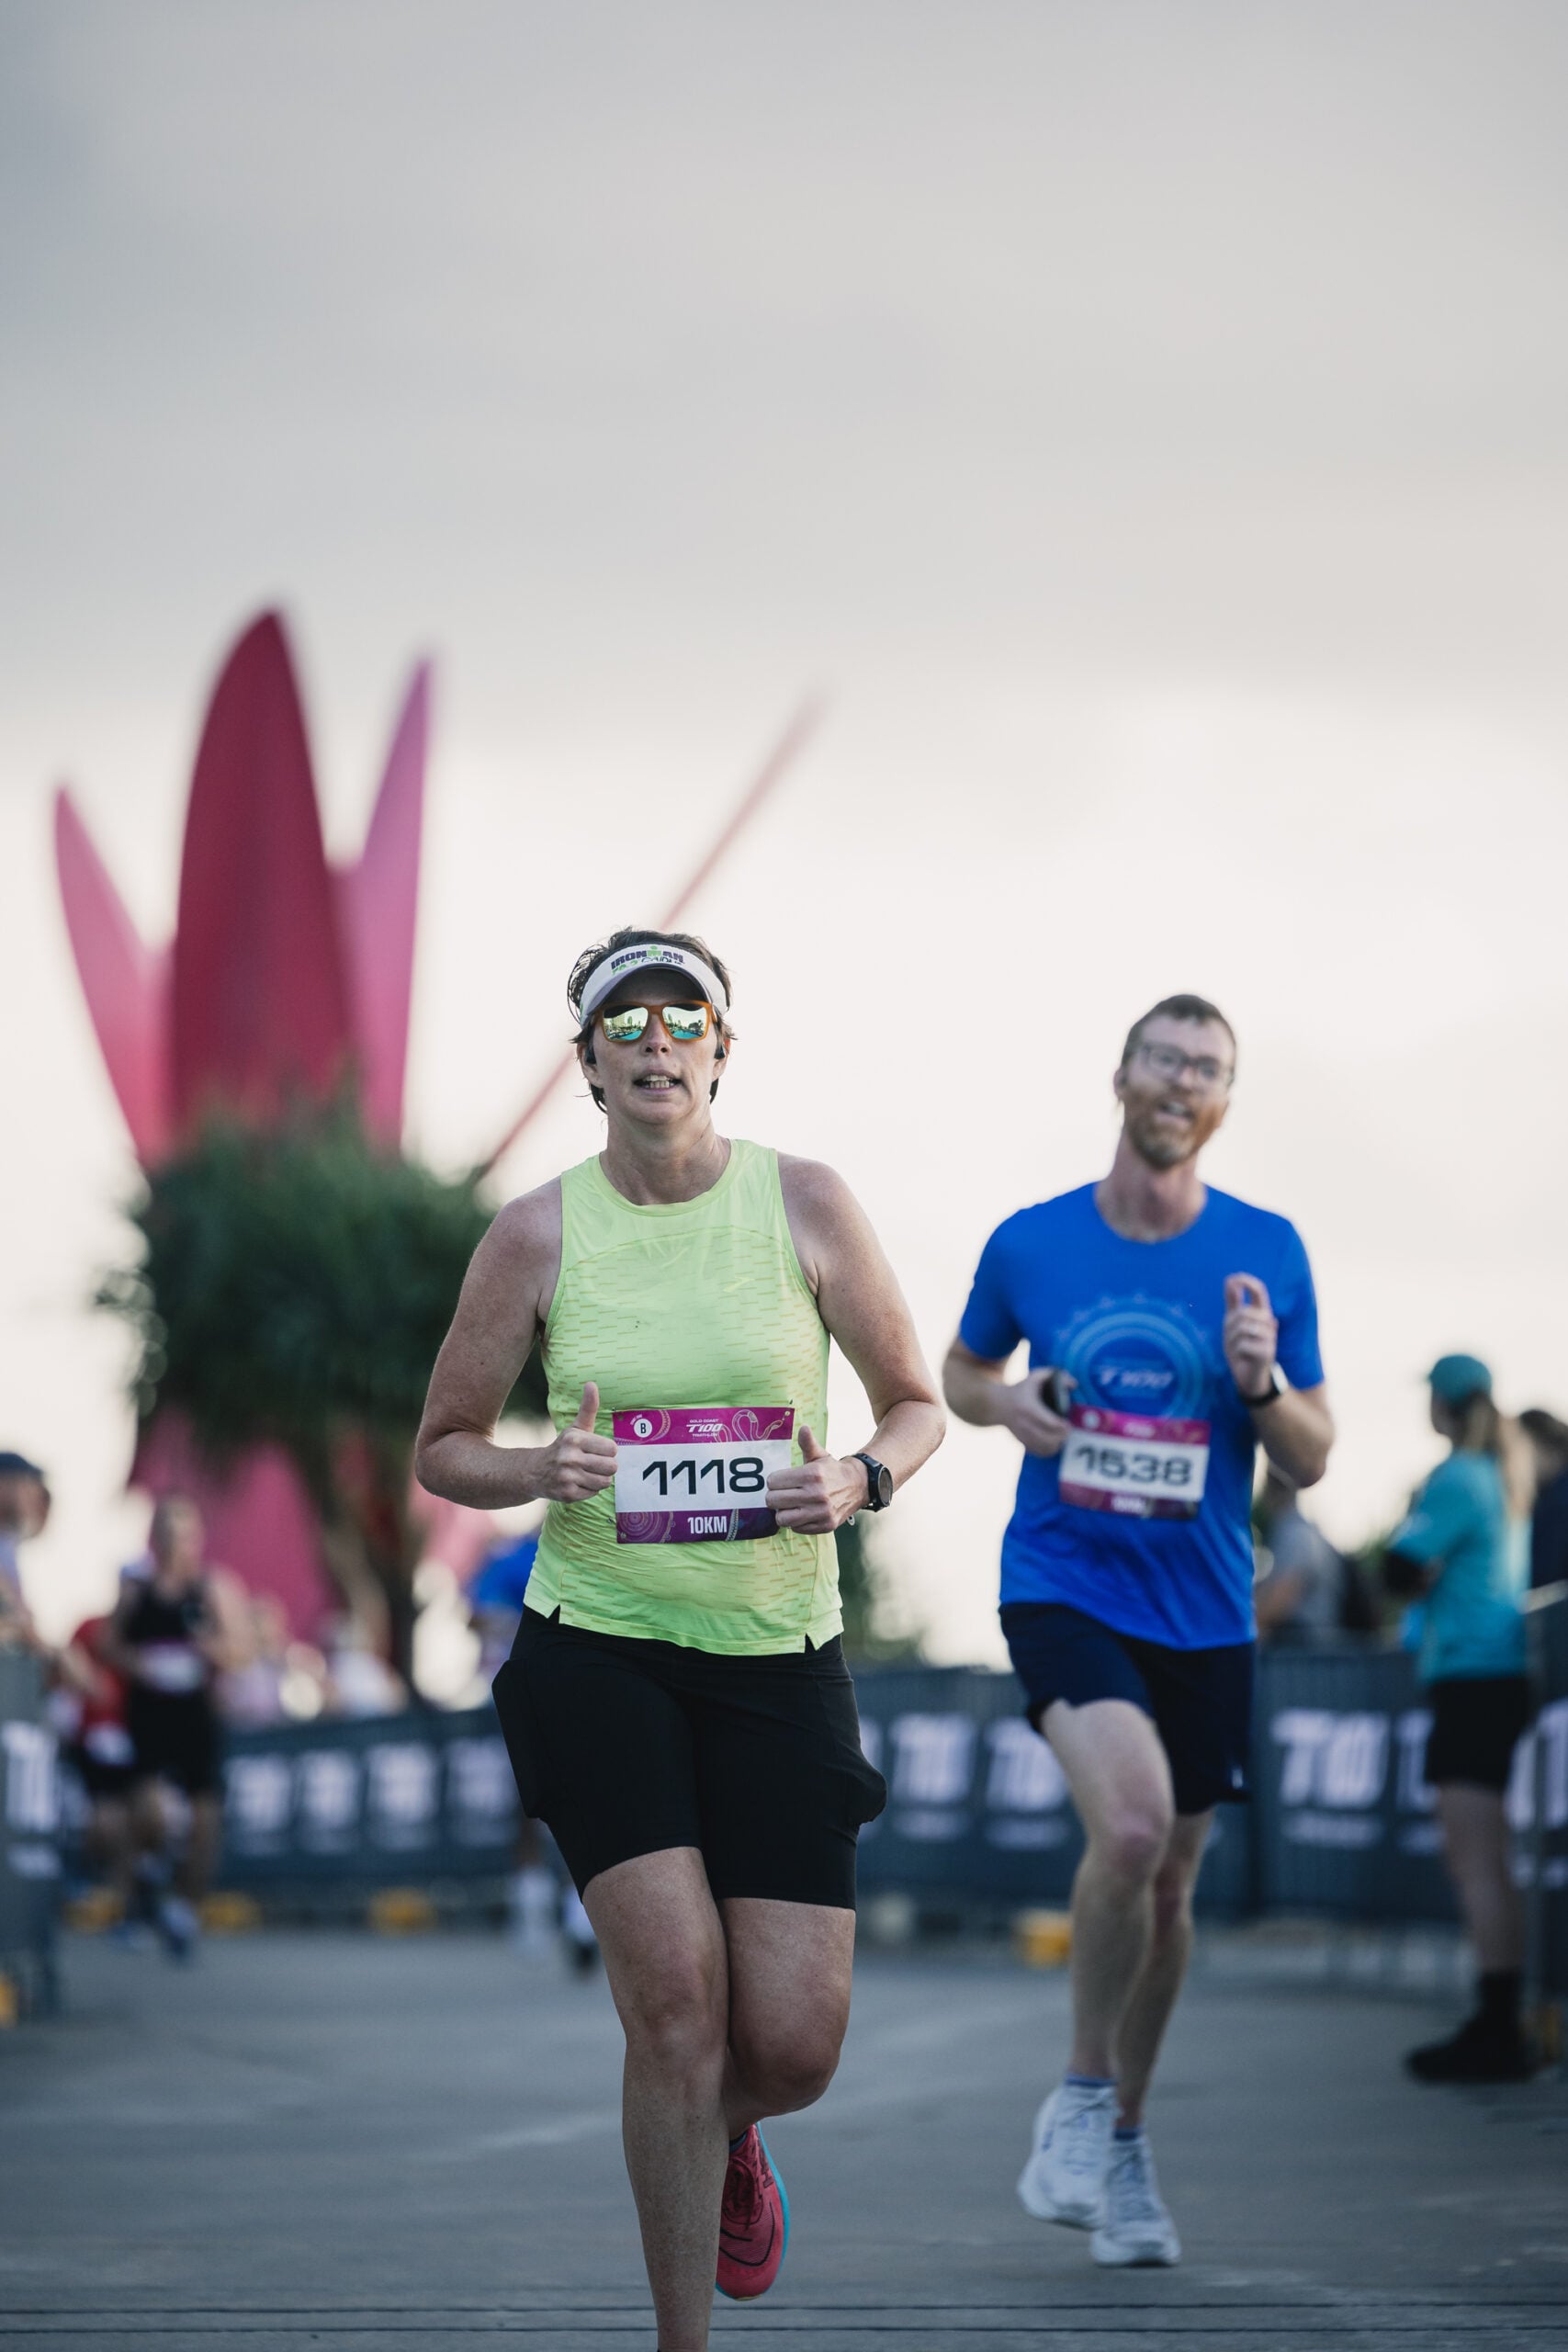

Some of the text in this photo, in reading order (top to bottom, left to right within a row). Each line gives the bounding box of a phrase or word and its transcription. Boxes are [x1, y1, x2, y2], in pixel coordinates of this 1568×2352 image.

[611, 945, 684, 969] IRONMAN
[640, 1423, 647, 1433] B
[686, 1423, 723, 1432] T100
[643, 1457, 765, 1495] 1118
[1076, 1444, 1192, 1487] 1538
[687, 1516, 728, 1534] 10KM
